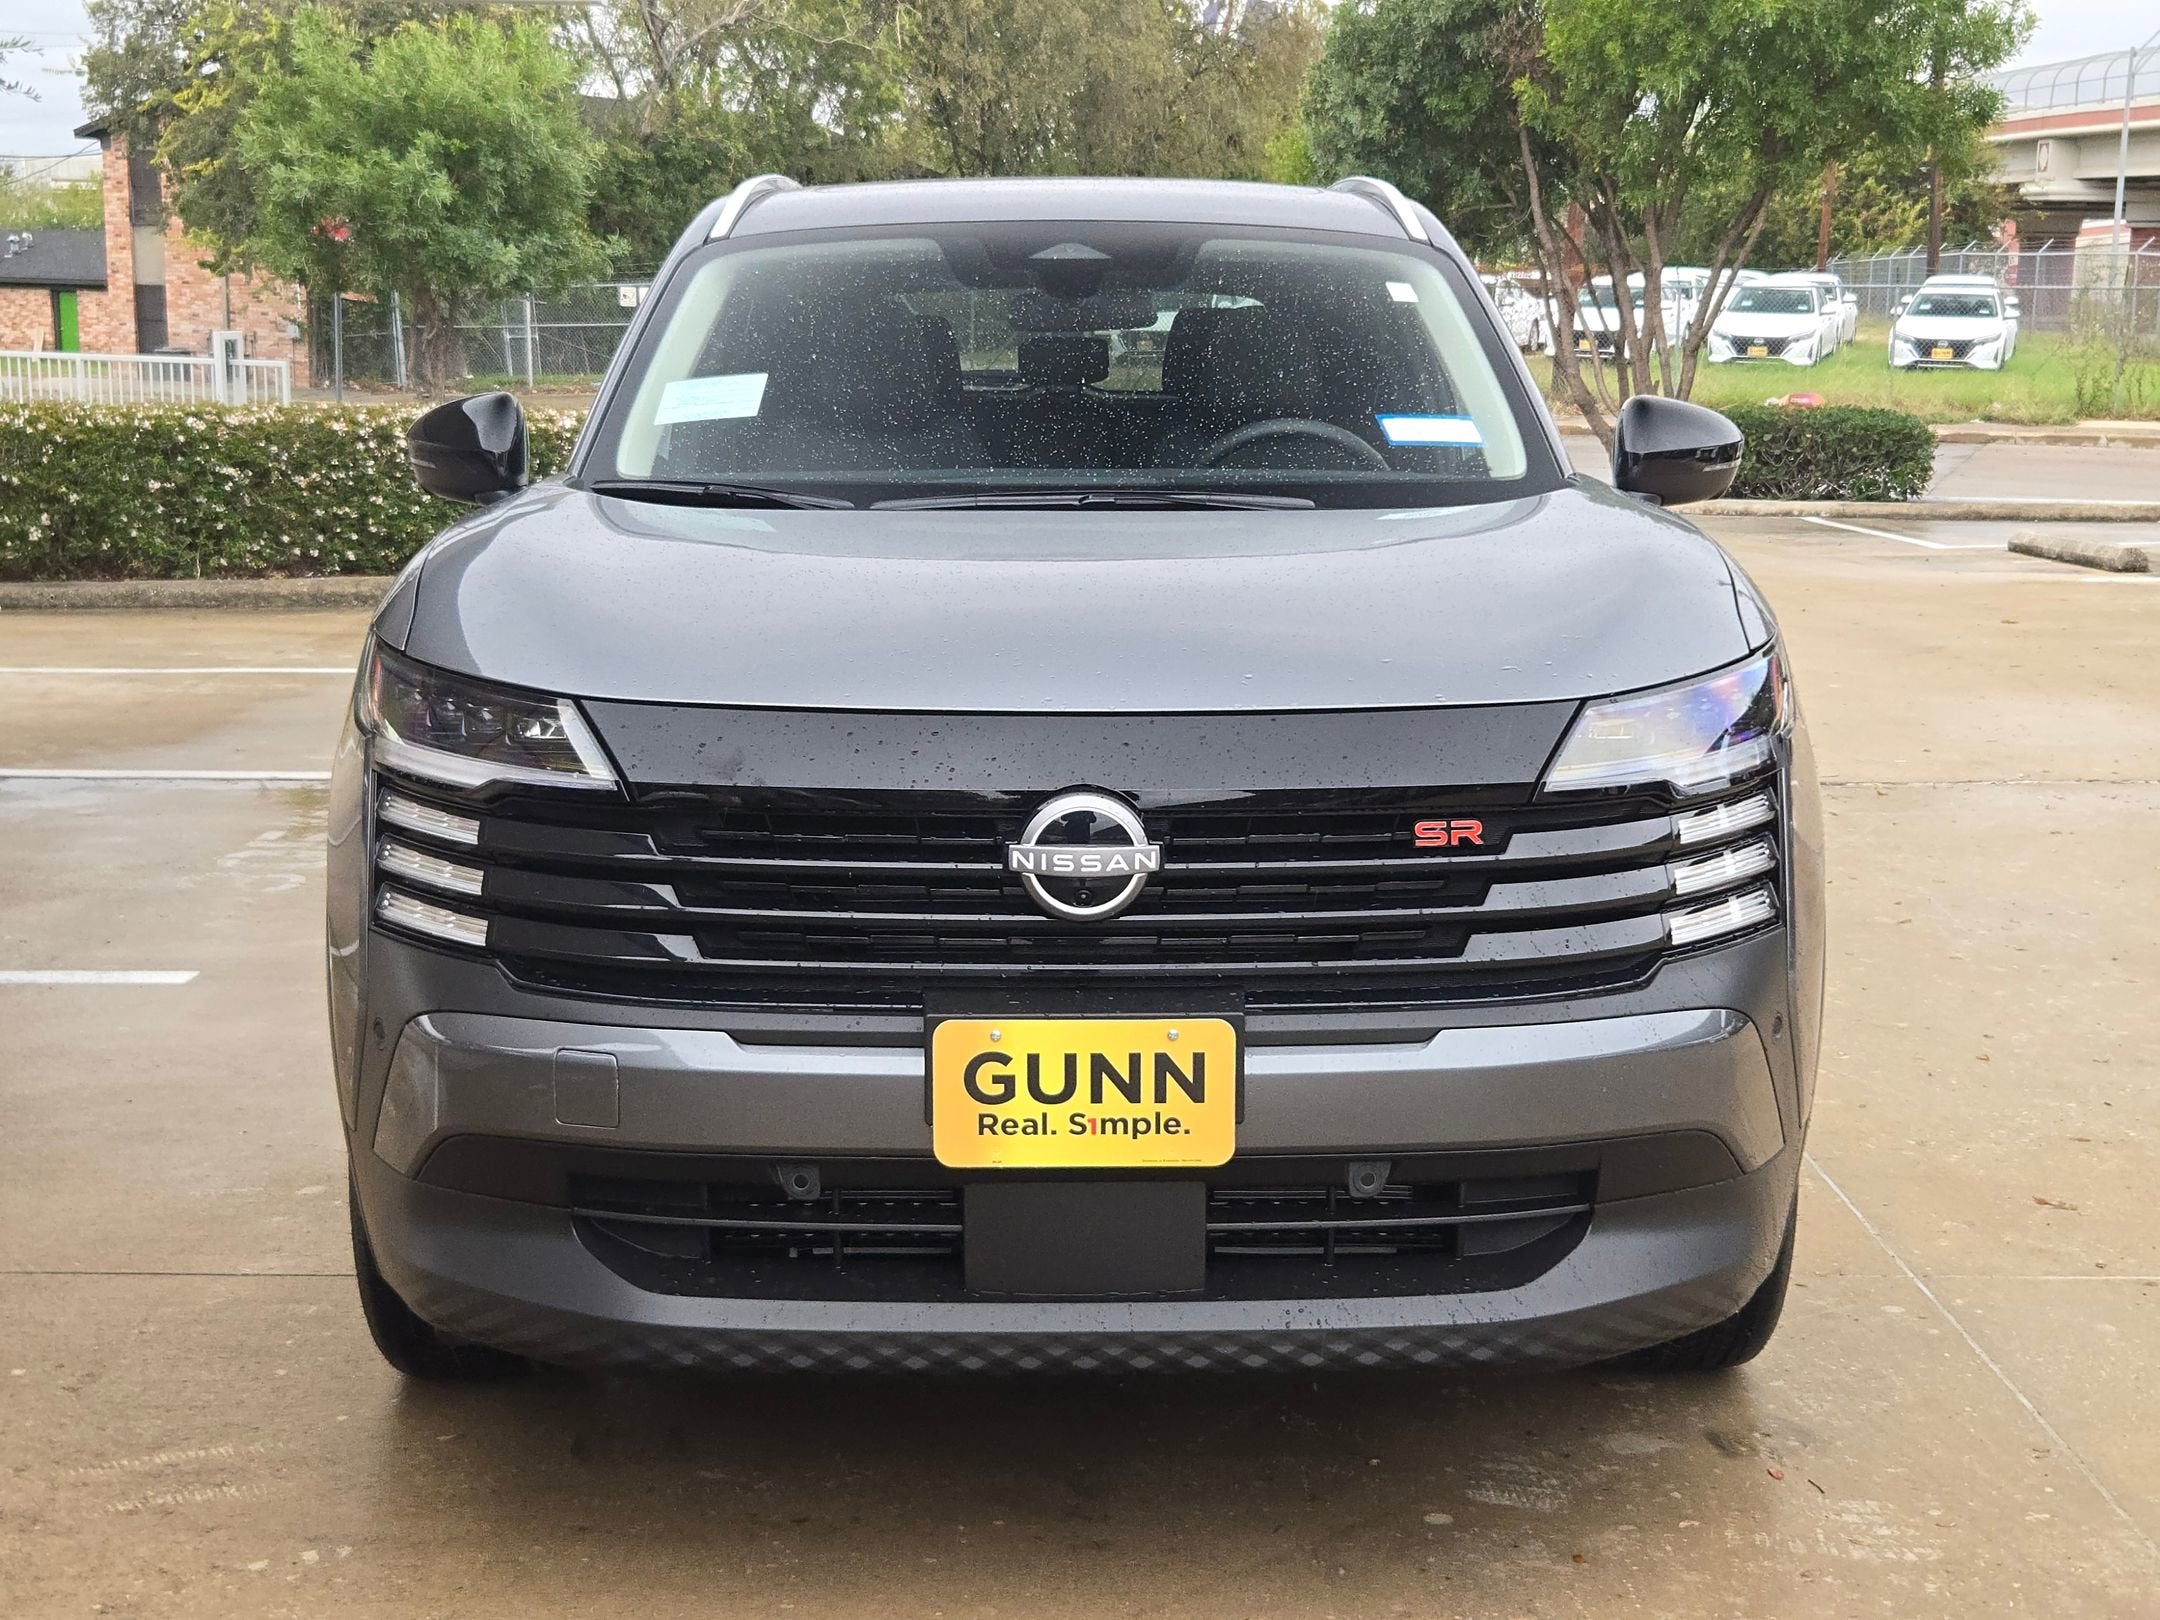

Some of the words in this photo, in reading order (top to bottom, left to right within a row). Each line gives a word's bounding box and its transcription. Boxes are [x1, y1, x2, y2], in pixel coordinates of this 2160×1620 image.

[1414, 820, 1484, 846] SR
[1012, 850, 1158, 873] NISSAN
[963, 1051, 1205, 1105] GUNN
[978, 1112, 1057, 1136] Real.
[1068, 1112, 1190, 1139] S1mple.
